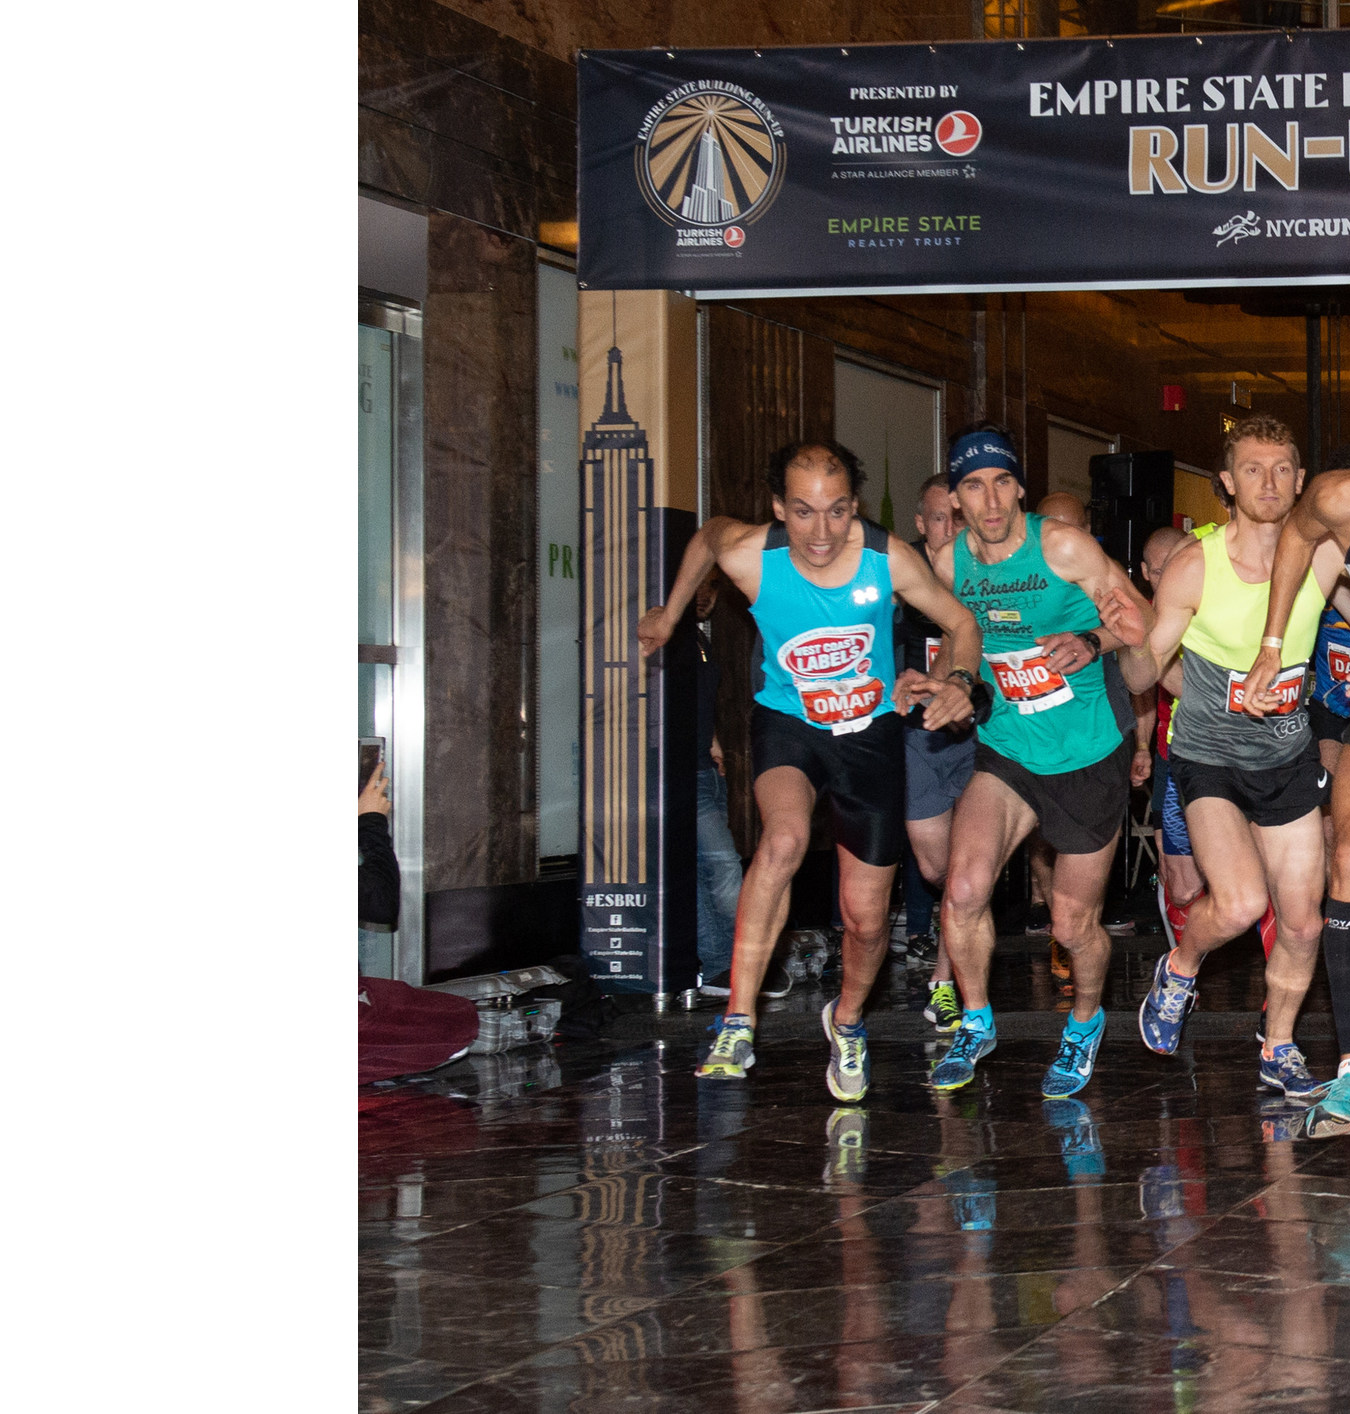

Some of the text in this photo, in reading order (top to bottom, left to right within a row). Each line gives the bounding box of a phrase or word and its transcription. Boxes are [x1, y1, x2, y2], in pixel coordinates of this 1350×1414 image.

[850, 84, 959, 100] PRESENTED BY
[1029, 76, 1191, 117] EMPIRE
[1202, 72, 1328, 112] STATE
[637, 79, 785, 141] EMPIRE STATE BUILDING RUN-UP
[830, 116, 933, 135] TURKISH
[832, 134, 933, 154] AIRLINES
[831, 168, 960, 179] A STAR ALLIANCE MEMBER
[676, 228, 724, 238] TURKISH
[828, 215, 982, 234] EMPIRE STATE
[676, 237, 724, 246] AIRLINES
[848, 236, 962, 248] REALTY TRUST
[549, 543, 578, 579] PR
[960, 579, 976, 597] La
[793, 637, 857, 656] WEST COAST
[797, 645, 860, 672] LABELS
[998, 666, 1049, 688] FABIO
[1023, 687, 1031, 695] 5
[1233, 685, 1300, 704] SUN
[813, 690, 876, 714] OMAR
[842, 709, 854, 718] 13
[586, 893, 647, 907] #ESBRU
